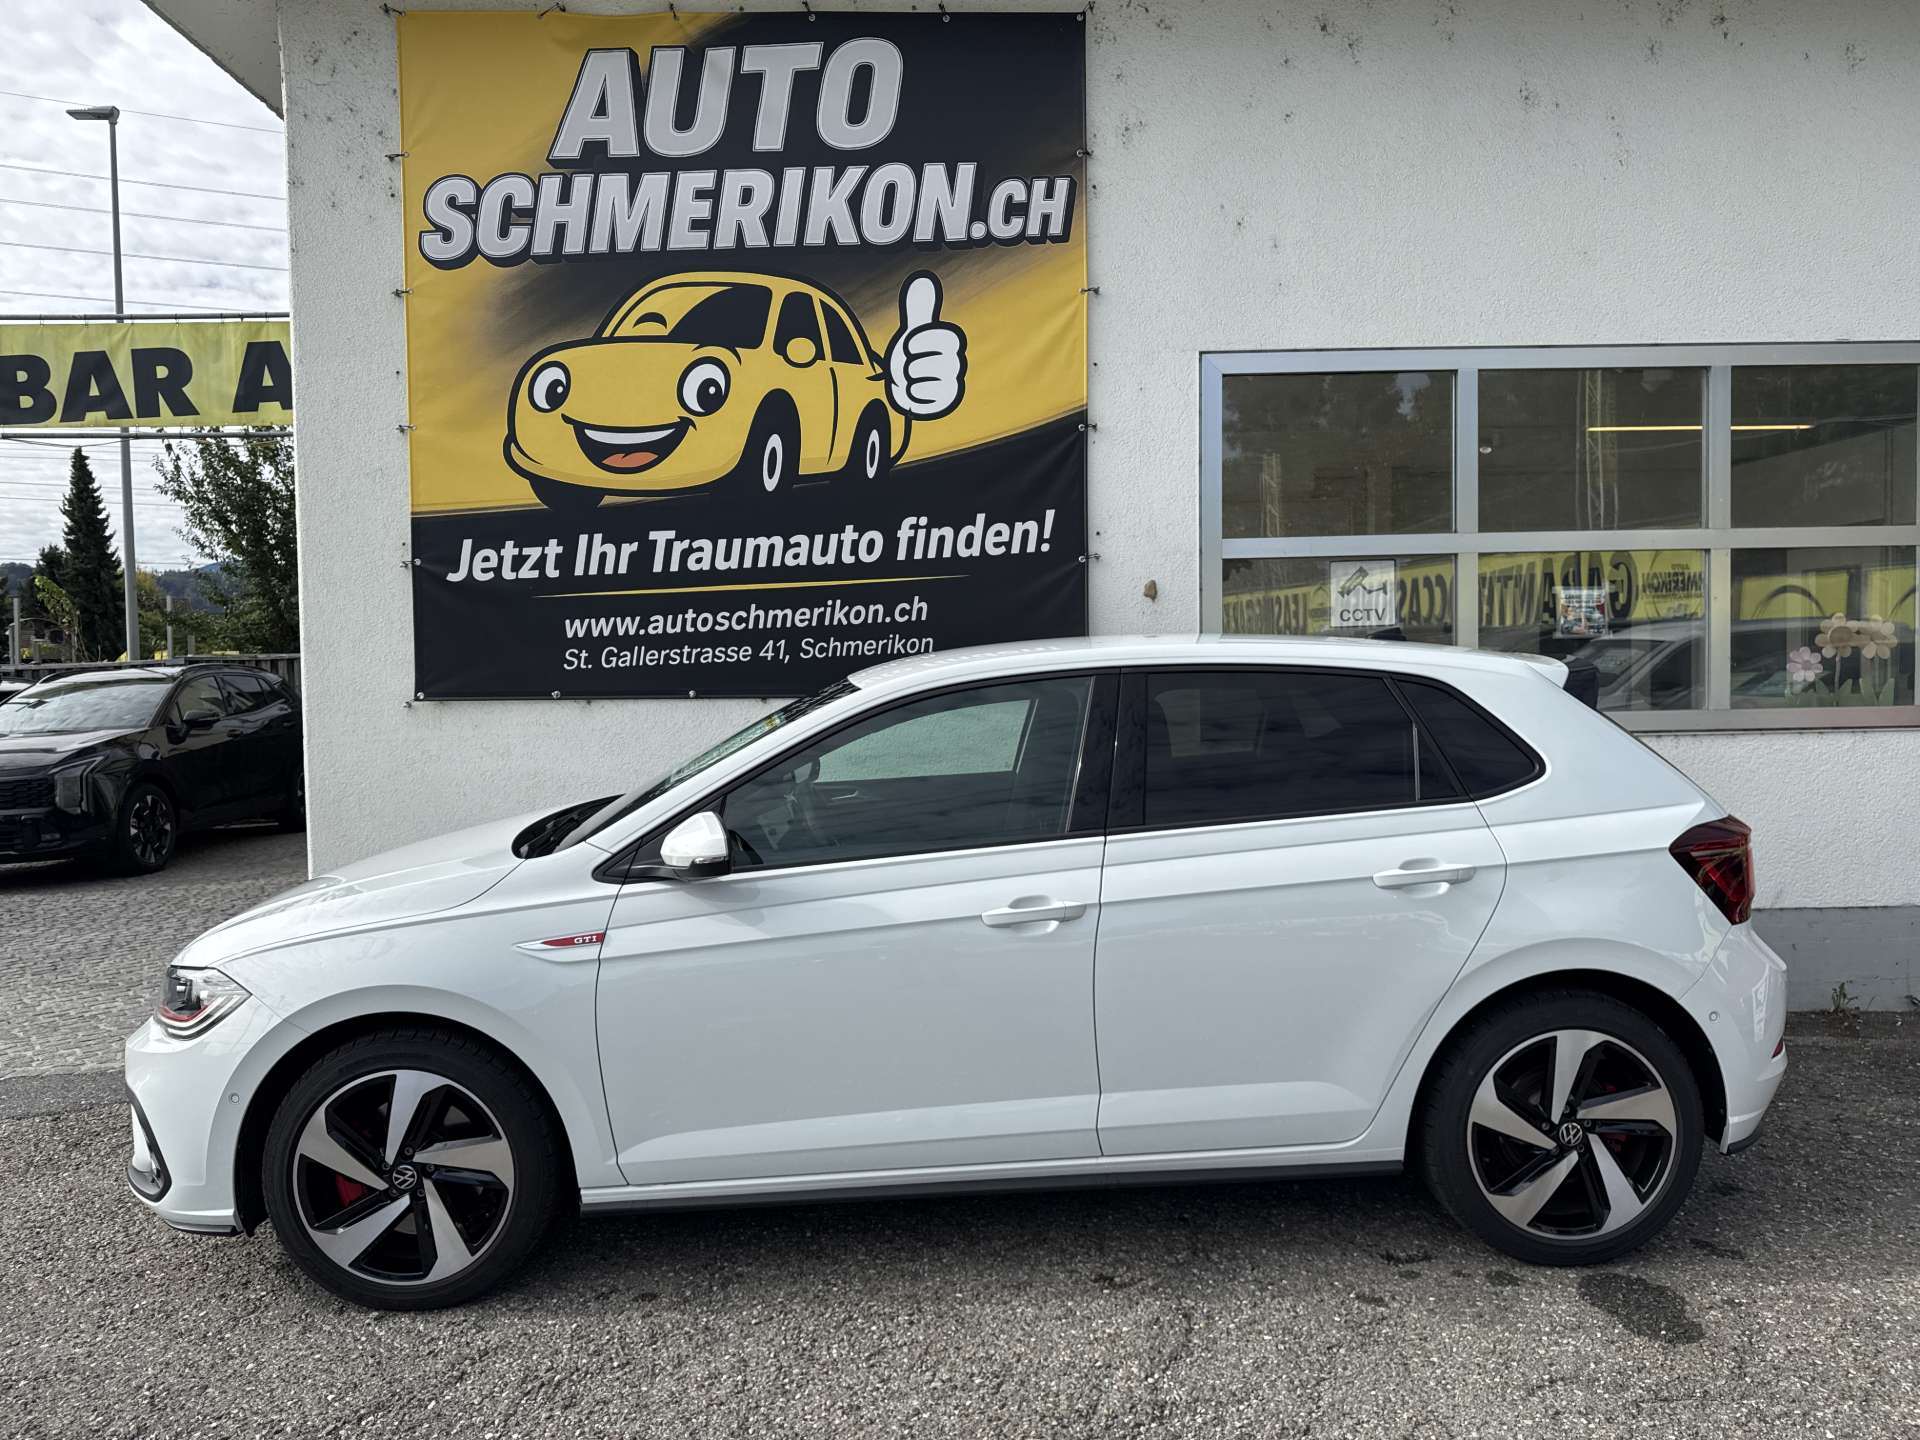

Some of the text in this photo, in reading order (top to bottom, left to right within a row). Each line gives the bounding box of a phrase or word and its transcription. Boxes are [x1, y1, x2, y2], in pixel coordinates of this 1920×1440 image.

[549, 37, 904, 160] AUTO
[421, 162, 1074, 262] SCHMERIKON.CH
[0, 340, 293, 425] BAR A
[446, 508, 1056, 582] Jetzt Ihr Traumauto finden!
[564, 596, 928, 639] www.autoschmerikon.ch
[1339, 607, 1386, 624] CCTV
[564, 634, 934, 670] St. Gallerstrasse 41, Schmerikon
[574, 935, 597, 943] GTI
